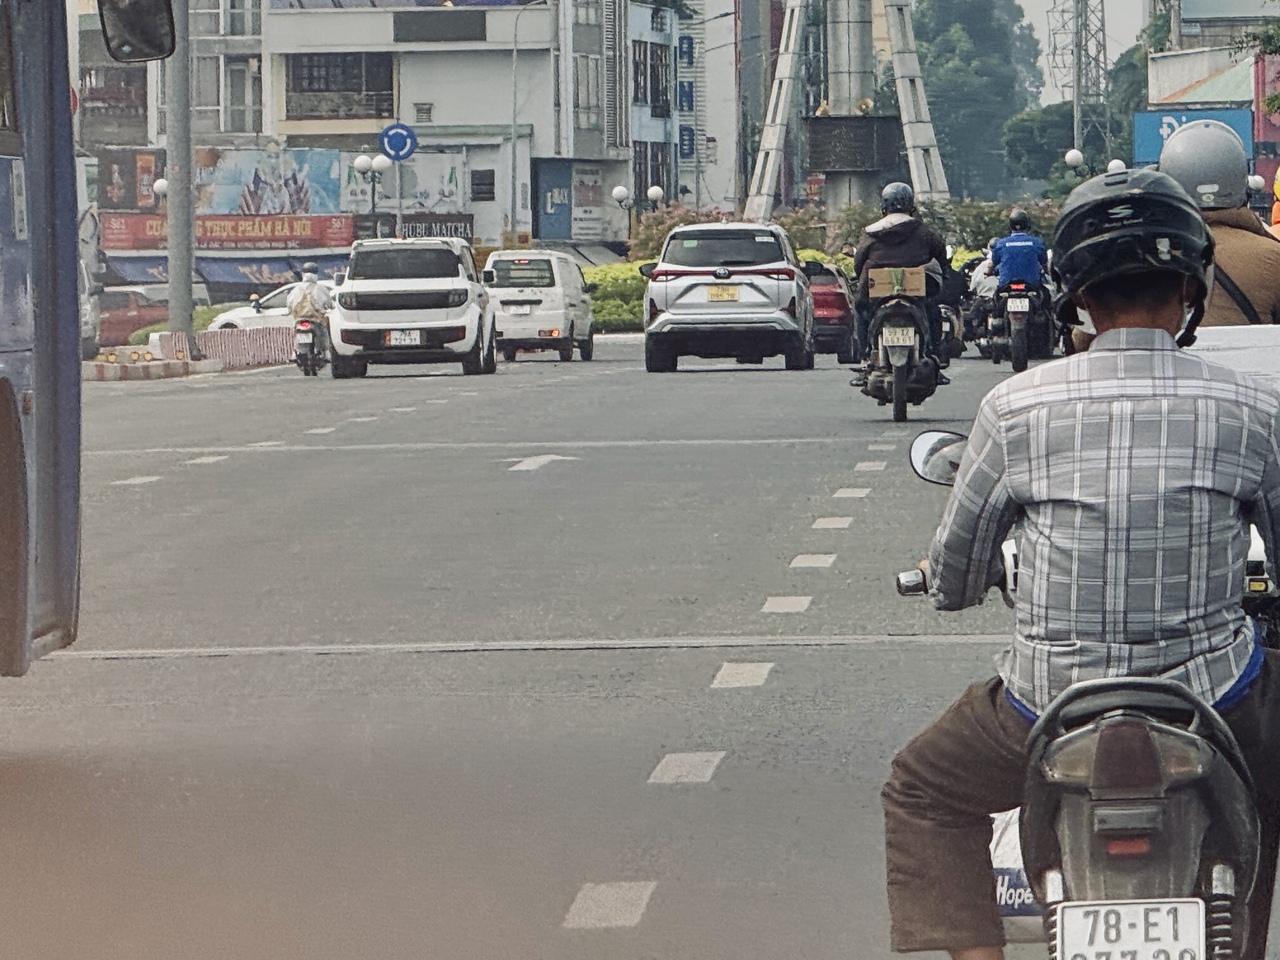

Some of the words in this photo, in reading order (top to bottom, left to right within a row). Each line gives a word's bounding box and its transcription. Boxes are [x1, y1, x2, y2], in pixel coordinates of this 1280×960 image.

[432, 222, 472, 239] MATCHA
[996, 875, 1035, 909] Hope
[1083, 906, 1179, 947] 78-E1
